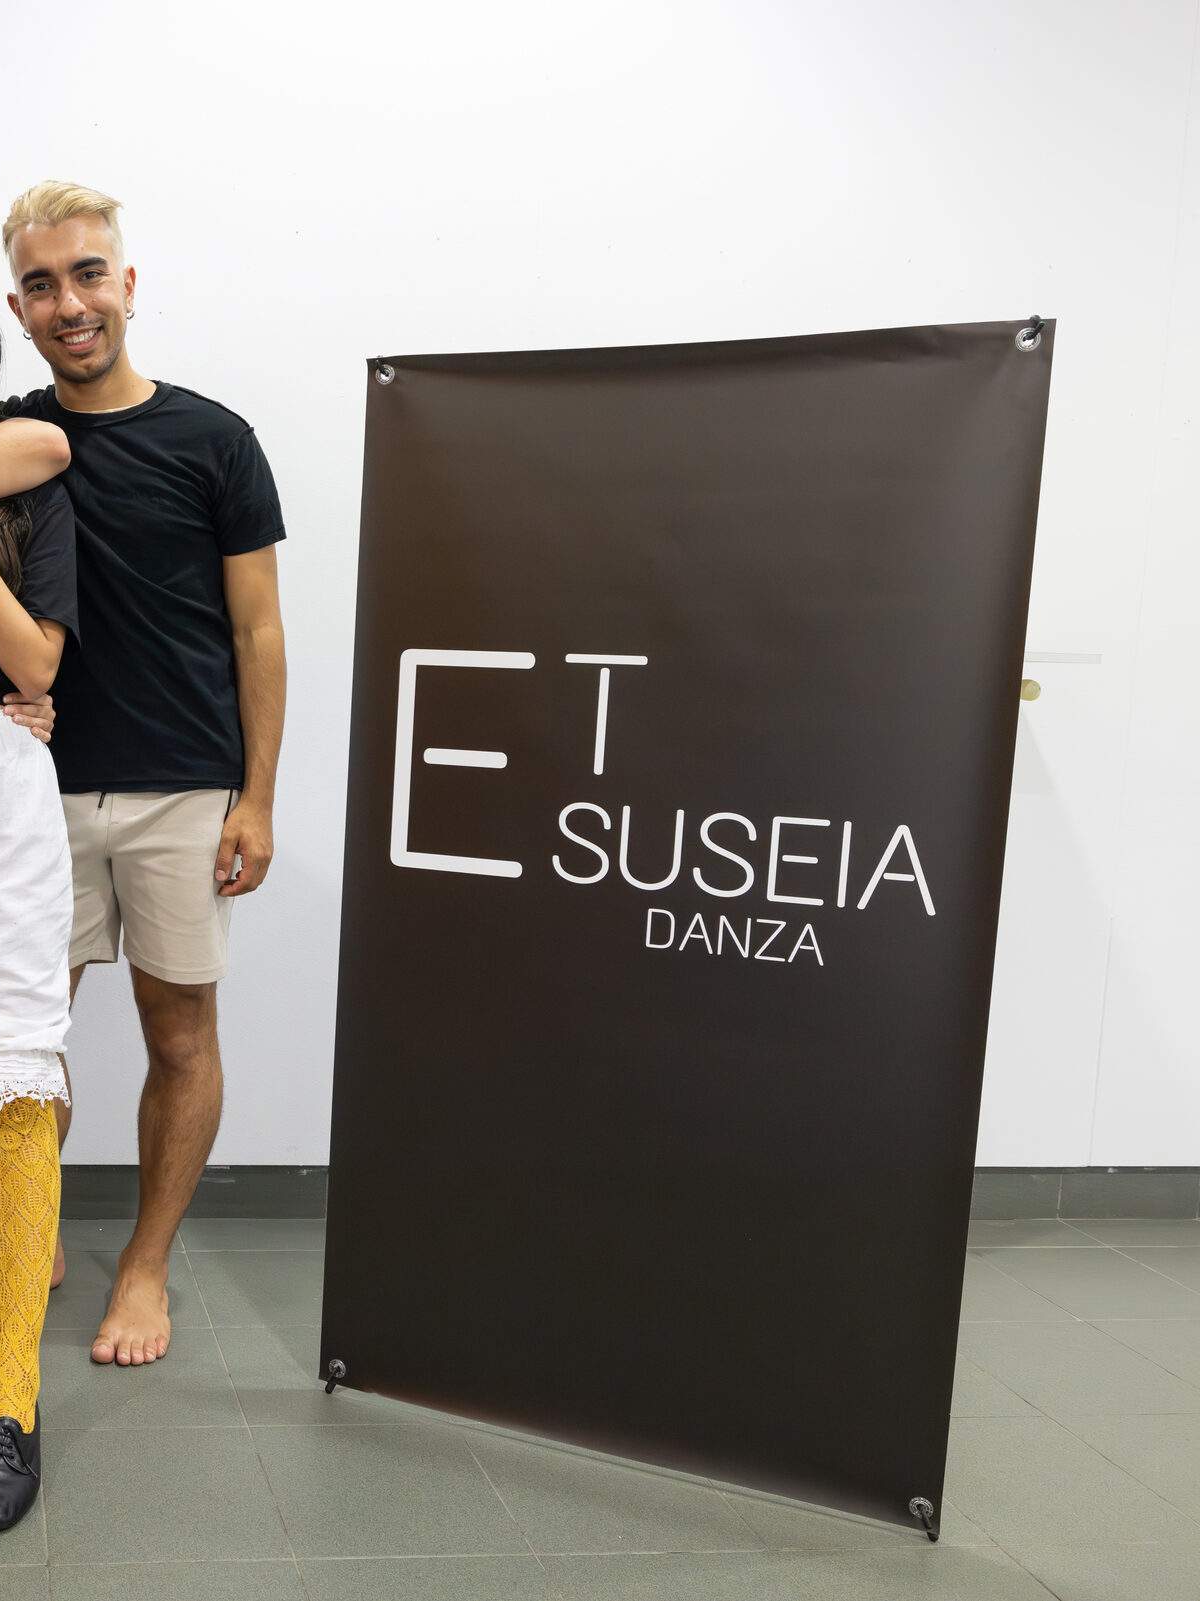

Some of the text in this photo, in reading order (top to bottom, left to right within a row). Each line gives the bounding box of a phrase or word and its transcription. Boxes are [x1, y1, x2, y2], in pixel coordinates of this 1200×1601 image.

[390, 648, 648, 878] ET
[552, 802, 936, 916] SUSEIA
[645, 908, 824, 966] DANZA
